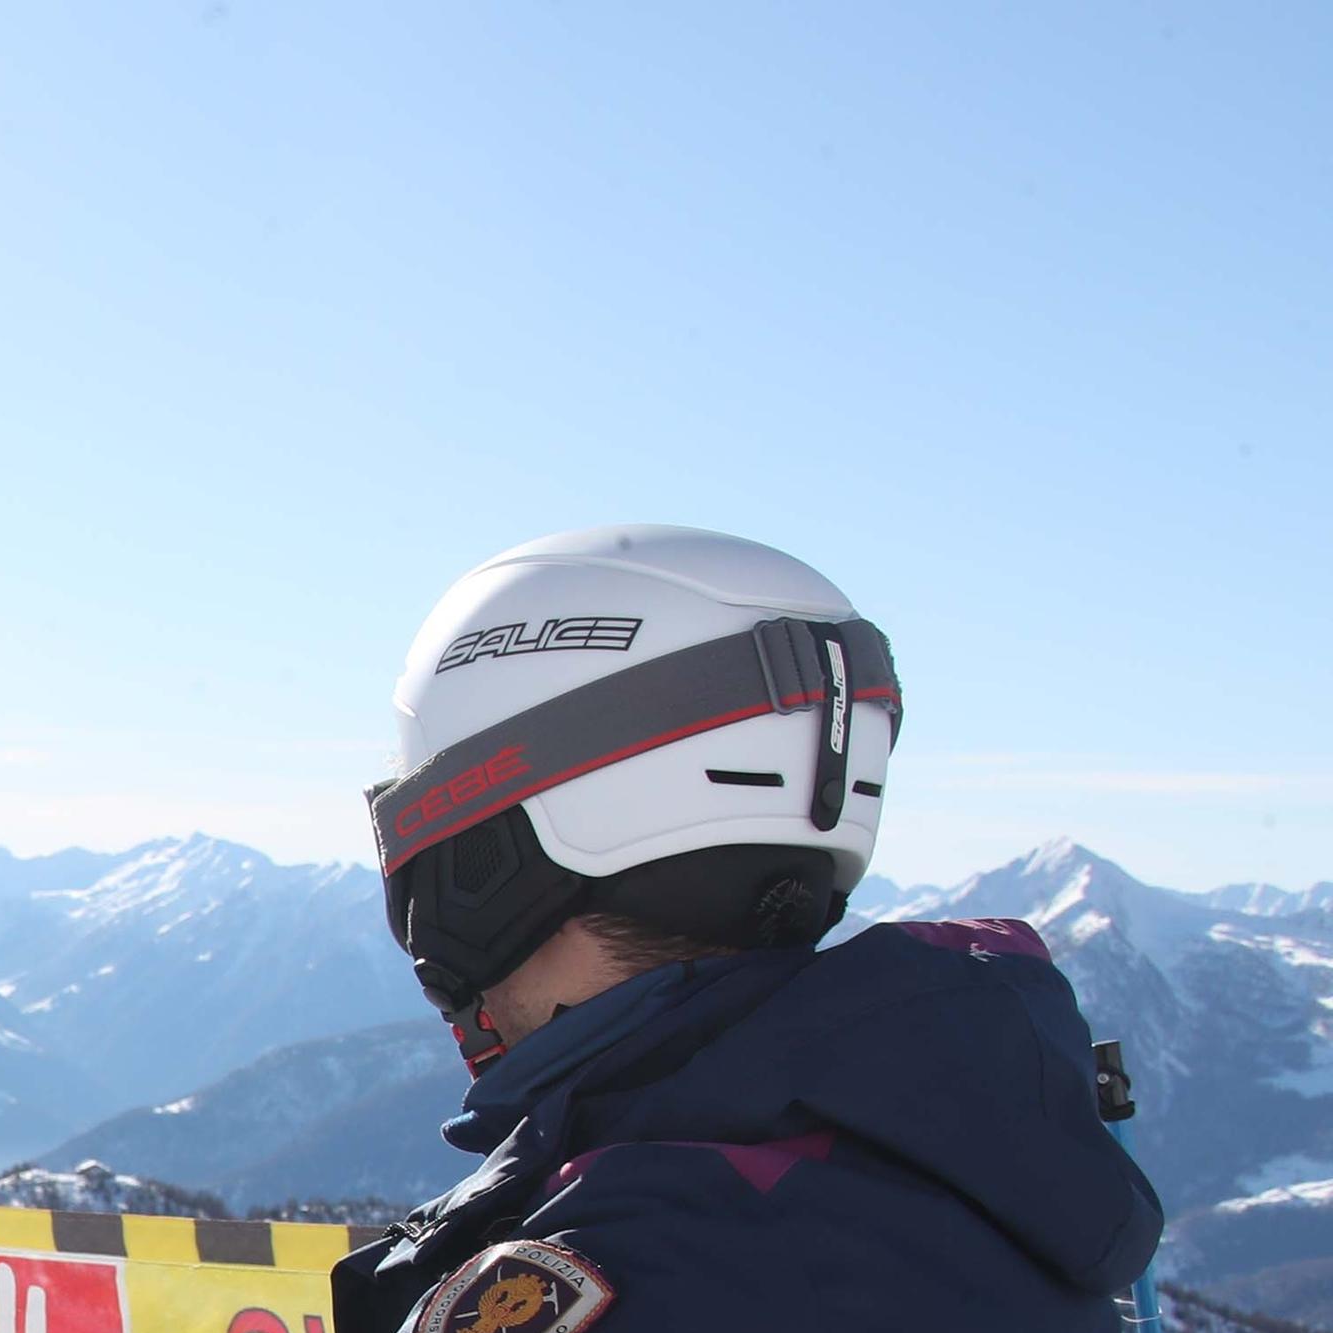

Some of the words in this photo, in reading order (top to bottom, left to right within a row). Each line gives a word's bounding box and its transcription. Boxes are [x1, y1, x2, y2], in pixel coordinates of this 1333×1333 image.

[435, 616, 643, 675] SALICE
[825, 639, 847, 754] SALICE
[514, 1247, 586, 1289] POLIZIA
